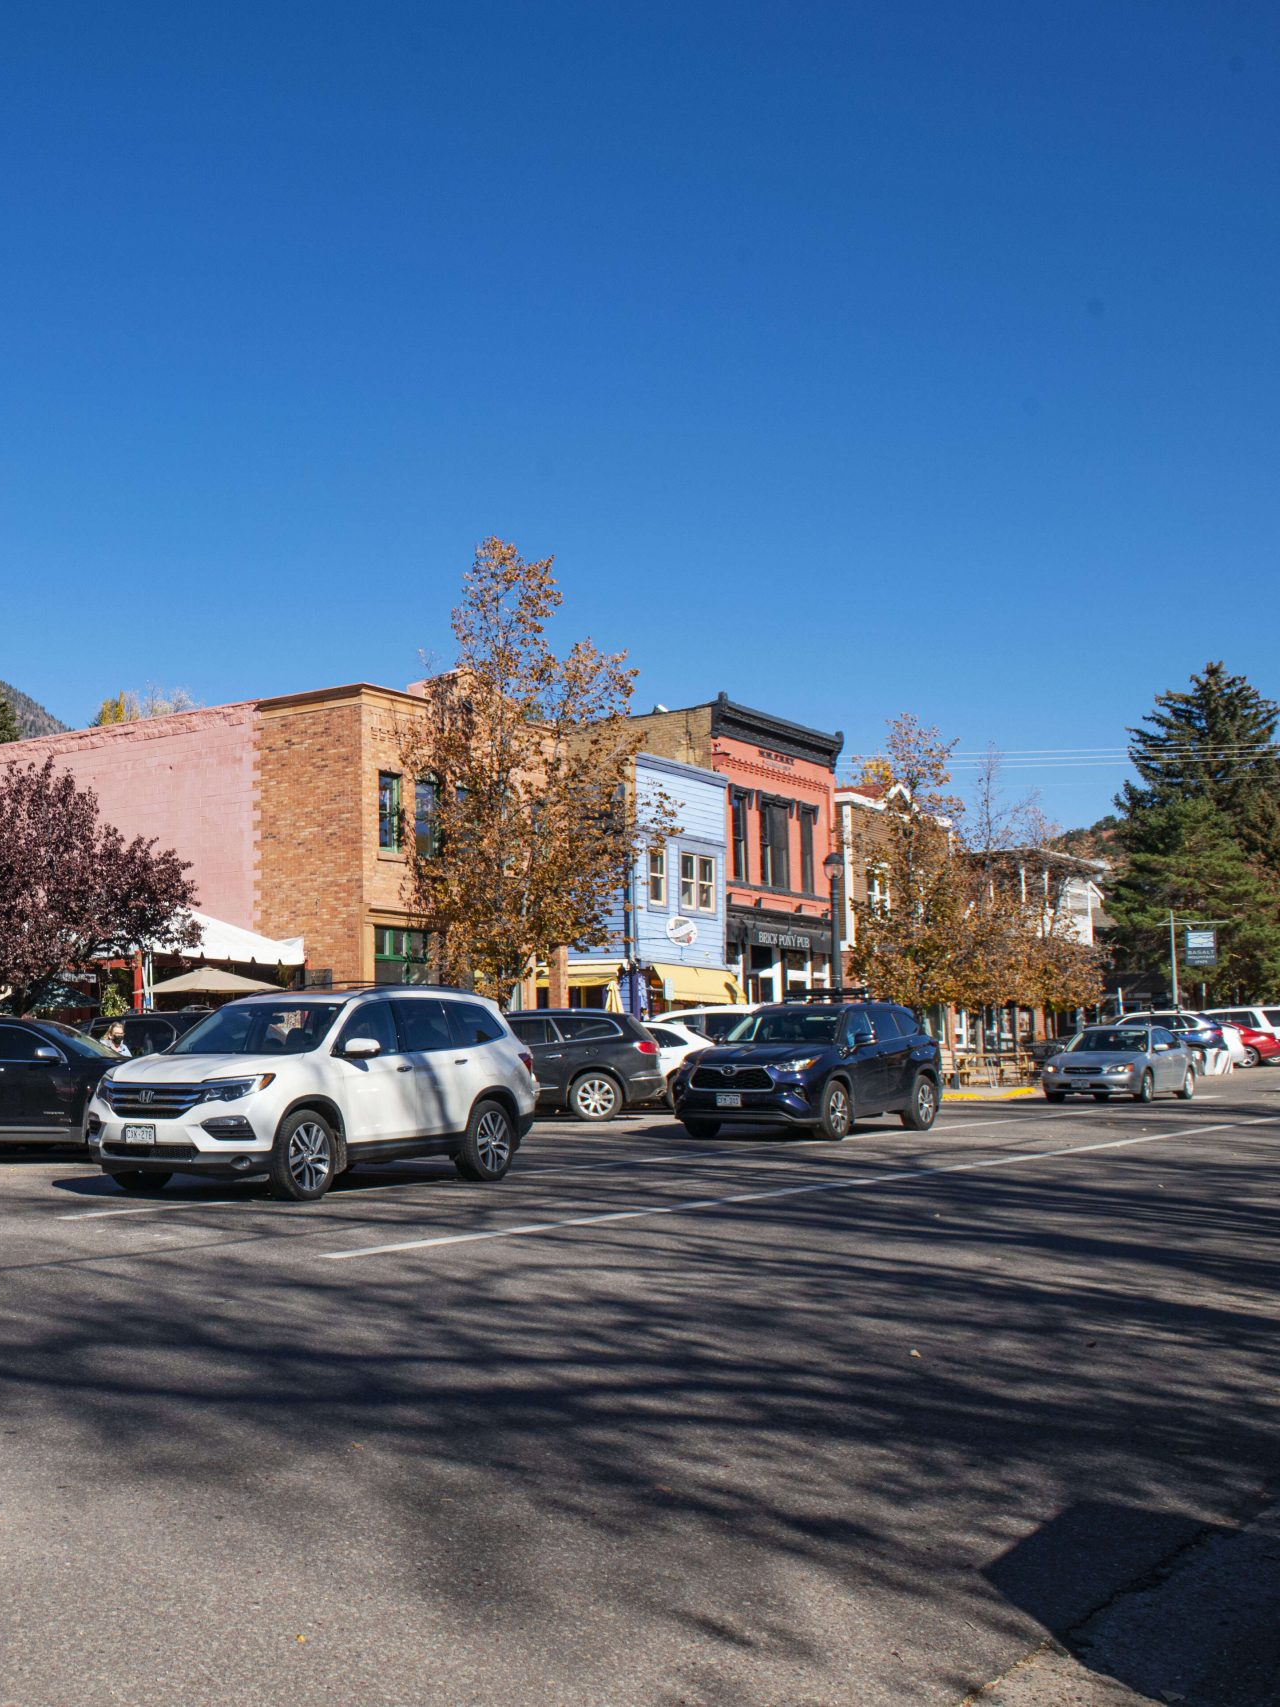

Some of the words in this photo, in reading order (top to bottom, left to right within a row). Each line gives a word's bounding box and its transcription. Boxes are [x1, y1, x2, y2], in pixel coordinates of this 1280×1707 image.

[758, 931, 778, 945] BRICK
[779, 934, 797, 947] PONY
[797, 936, 810, 948] PUB
